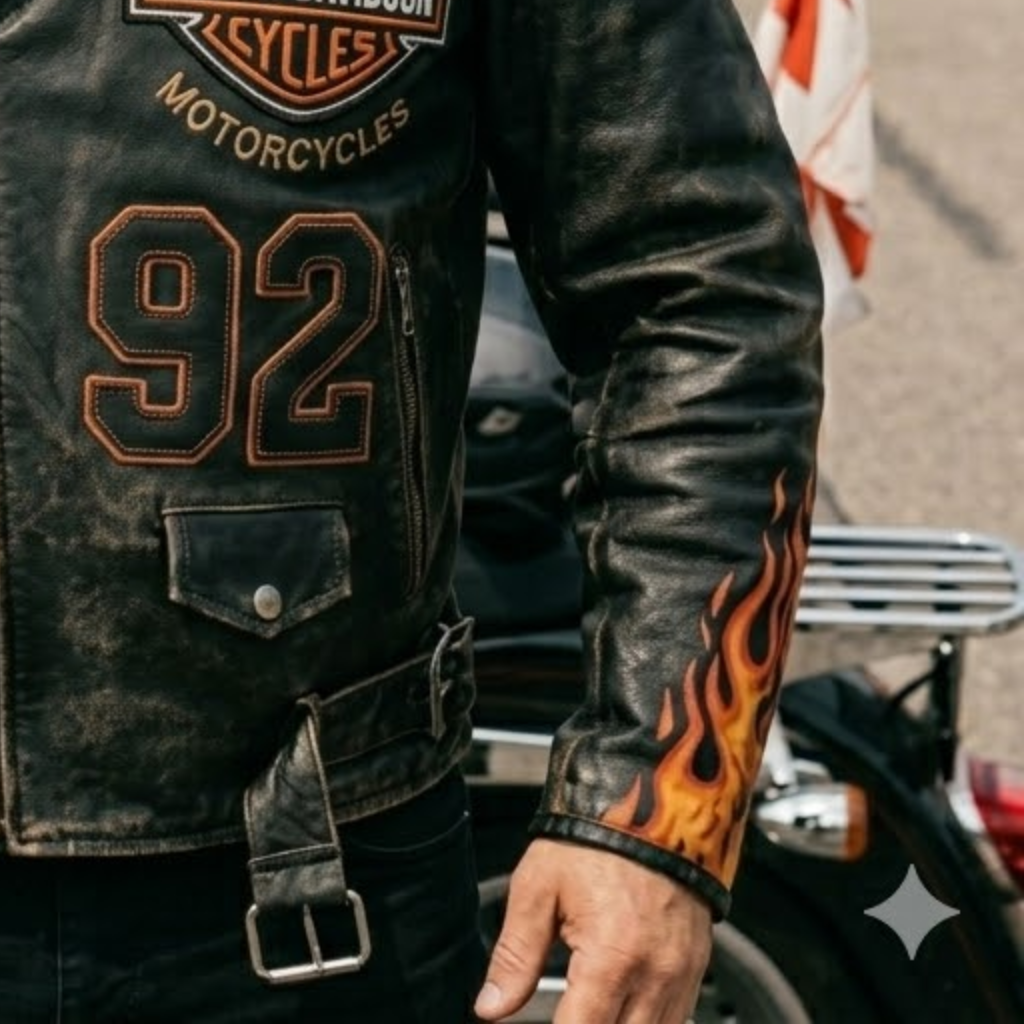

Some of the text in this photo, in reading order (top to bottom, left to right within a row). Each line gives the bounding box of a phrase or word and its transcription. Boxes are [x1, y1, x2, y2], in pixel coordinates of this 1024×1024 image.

[227, 16, 376, 89] CYCLES
[155, 70, 410, 172] MOTORCYCLES
[83, 204, 386, 467] 92
